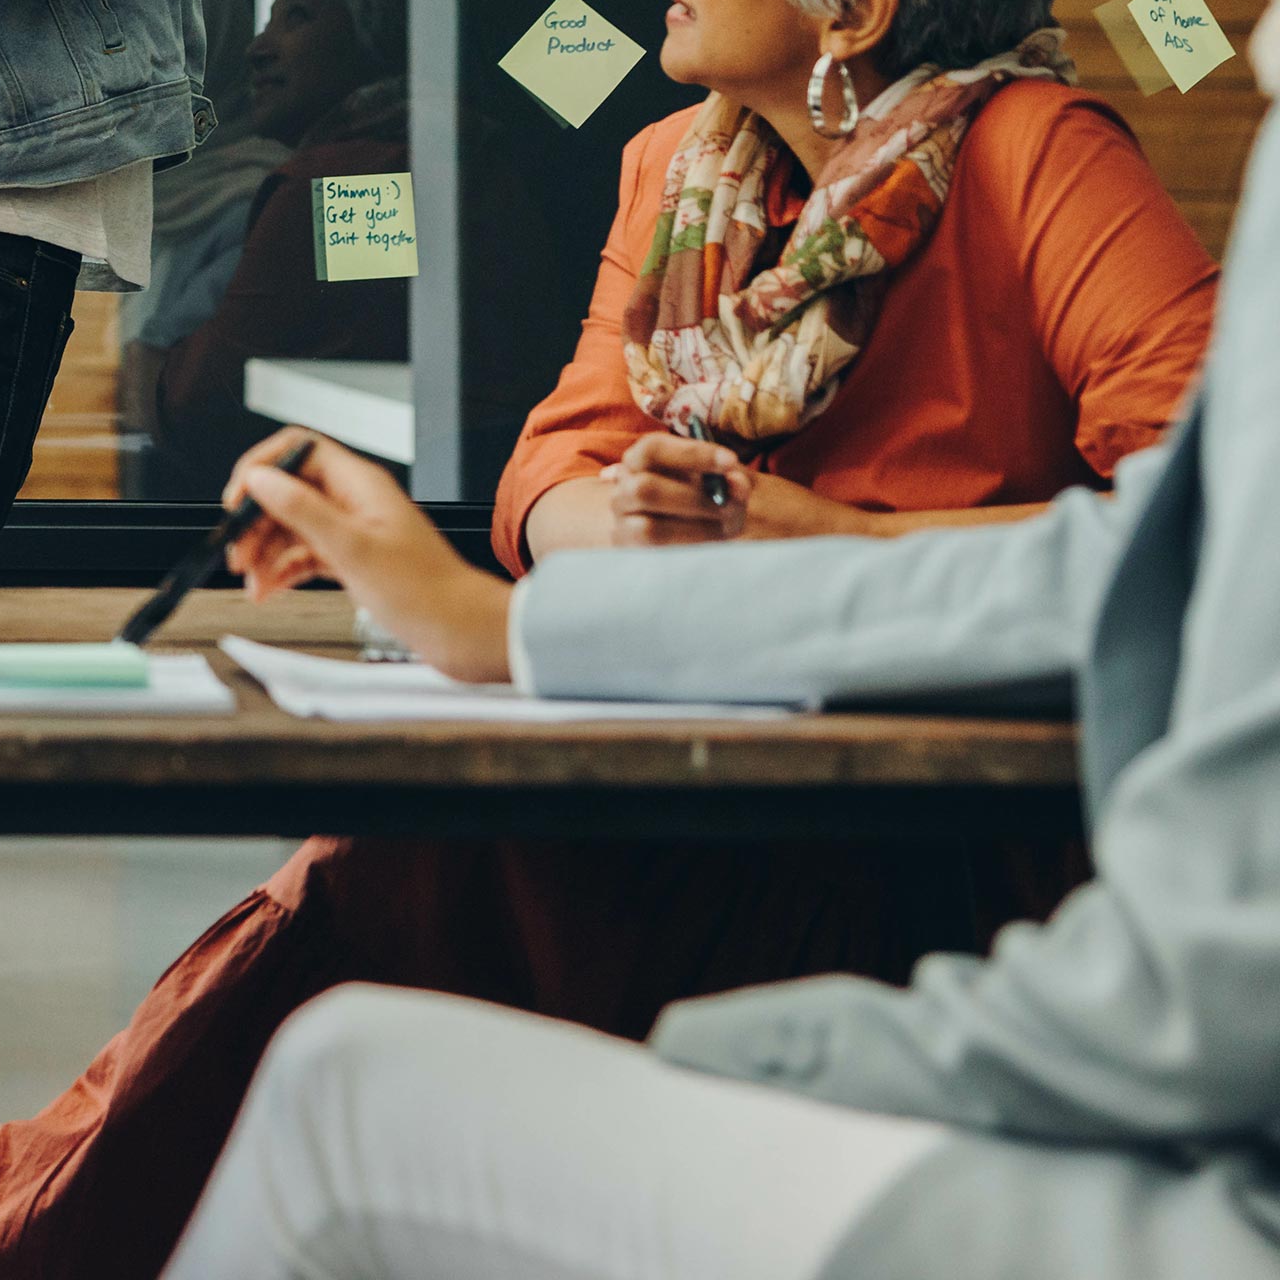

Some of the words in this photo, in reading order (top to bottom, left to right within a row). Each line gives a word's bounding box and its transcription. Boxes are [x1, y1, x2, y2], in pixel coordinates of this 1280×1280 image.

[544, 11, 587, 30] Good
[547, 36, 616, 55] Product
[326, 205, 356, 224] Get
